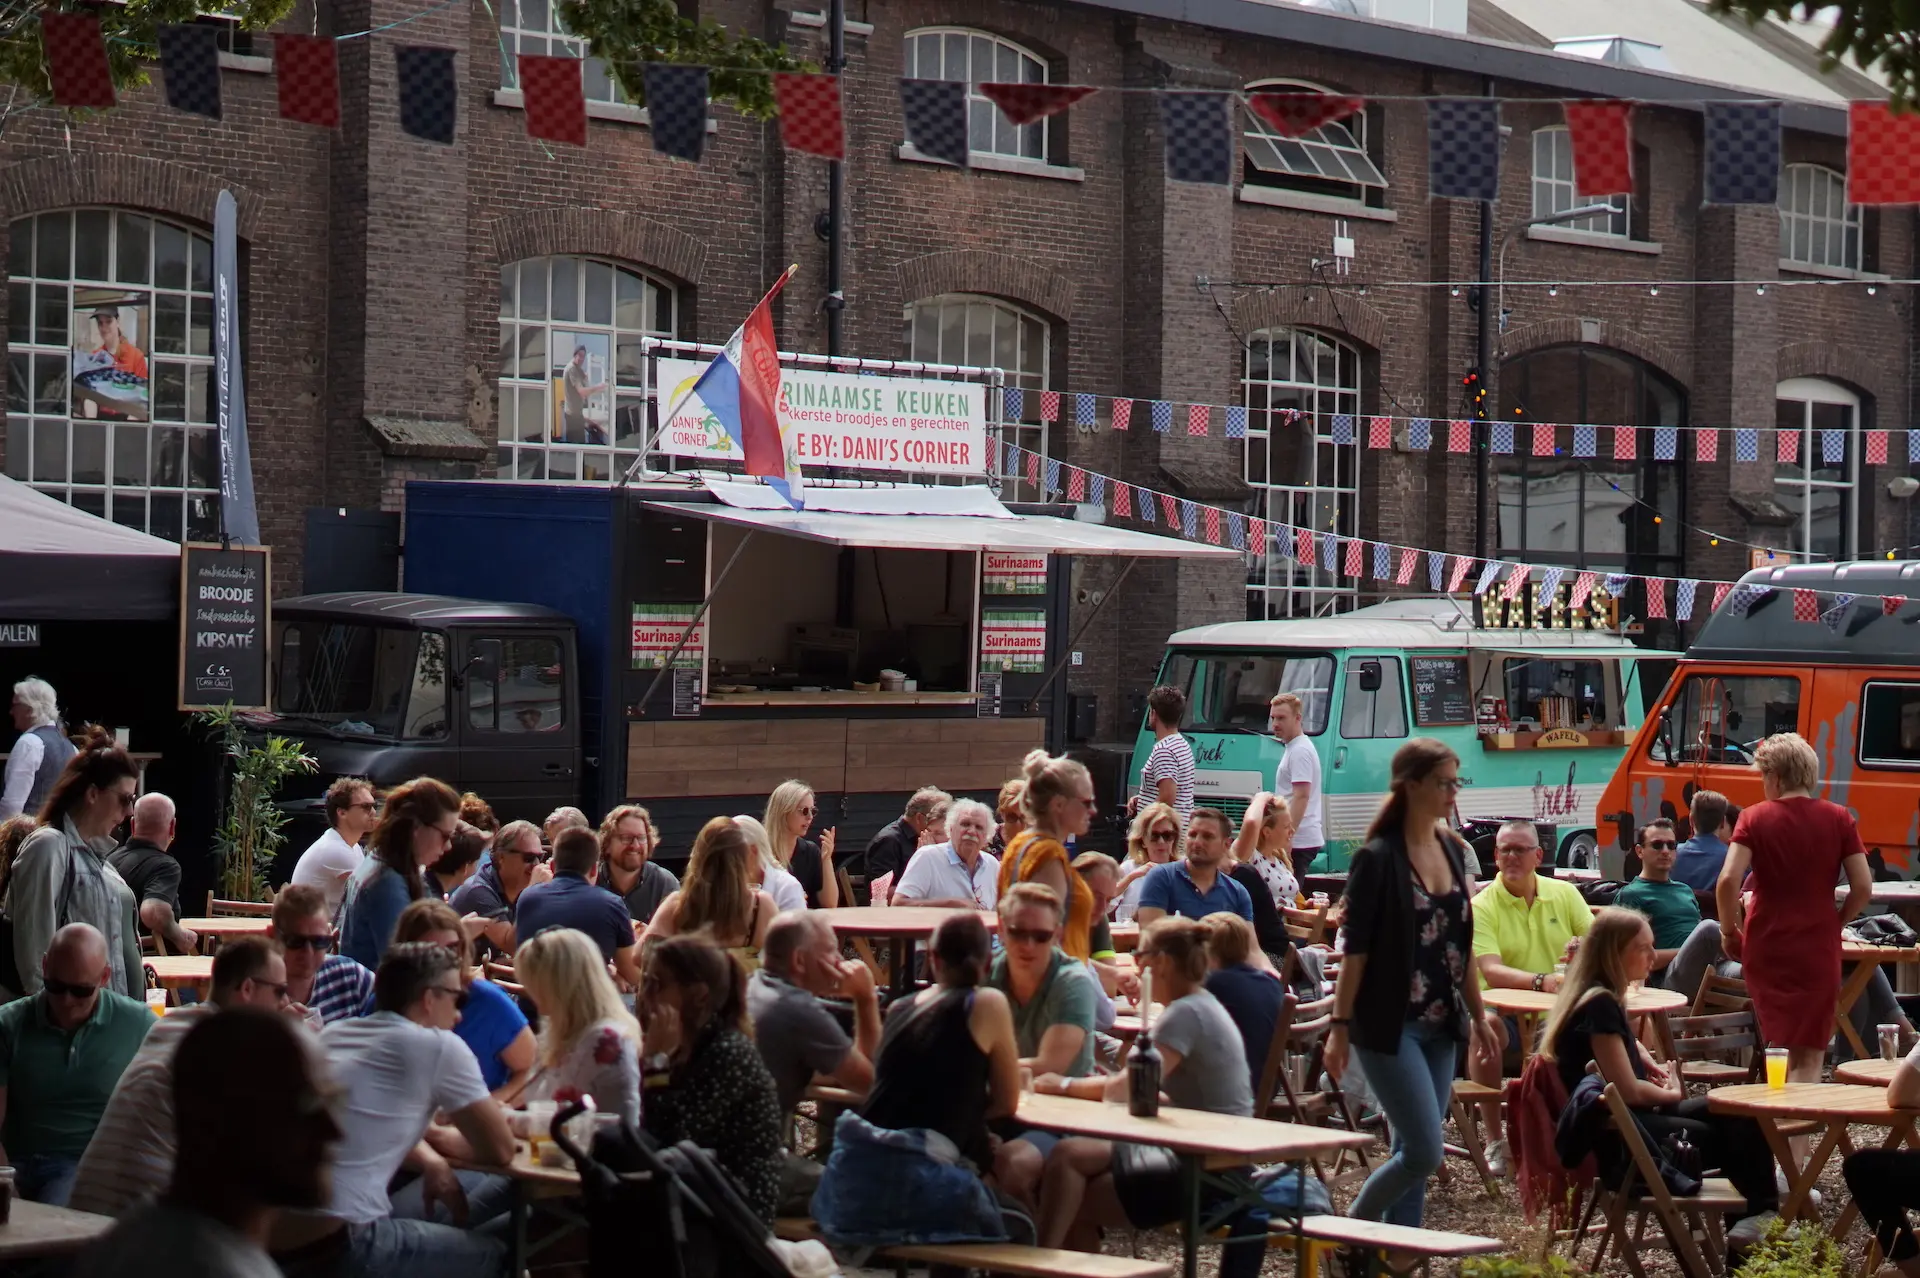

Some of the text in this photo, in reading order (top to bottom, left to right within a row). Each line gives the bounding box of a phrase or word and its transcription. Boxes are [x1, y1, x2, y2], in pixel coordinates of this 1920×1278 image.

[783, 381, 969, 416] RINAAMSE KEUKEN
[672, 417, 703, 430] DANI'S
[788, 406, 969, 431] kkerste broodjes en gerechten
[672, 431, 708, 447] CORNER
[811, 434, 837, 458] BY:
[843, 436, 899, 462] DANI'S
[903, 439, 970, 465] CORNER
[987, 555, 1044, 569] Surinaams
[199, 585, 254, 603] BROODJE
[0, 624, 37, 642] ALEN
[196, 628, 255, 649] KIPSATÉ
[634, 628, 700, 643] Surinaams
[985, 633, 1042, 647] Surinaams
[1546, 731, 1580, 743] WAFELS
[1195, 738, 1226, 764] trek
[1532, 761, 1581, 818] trek
